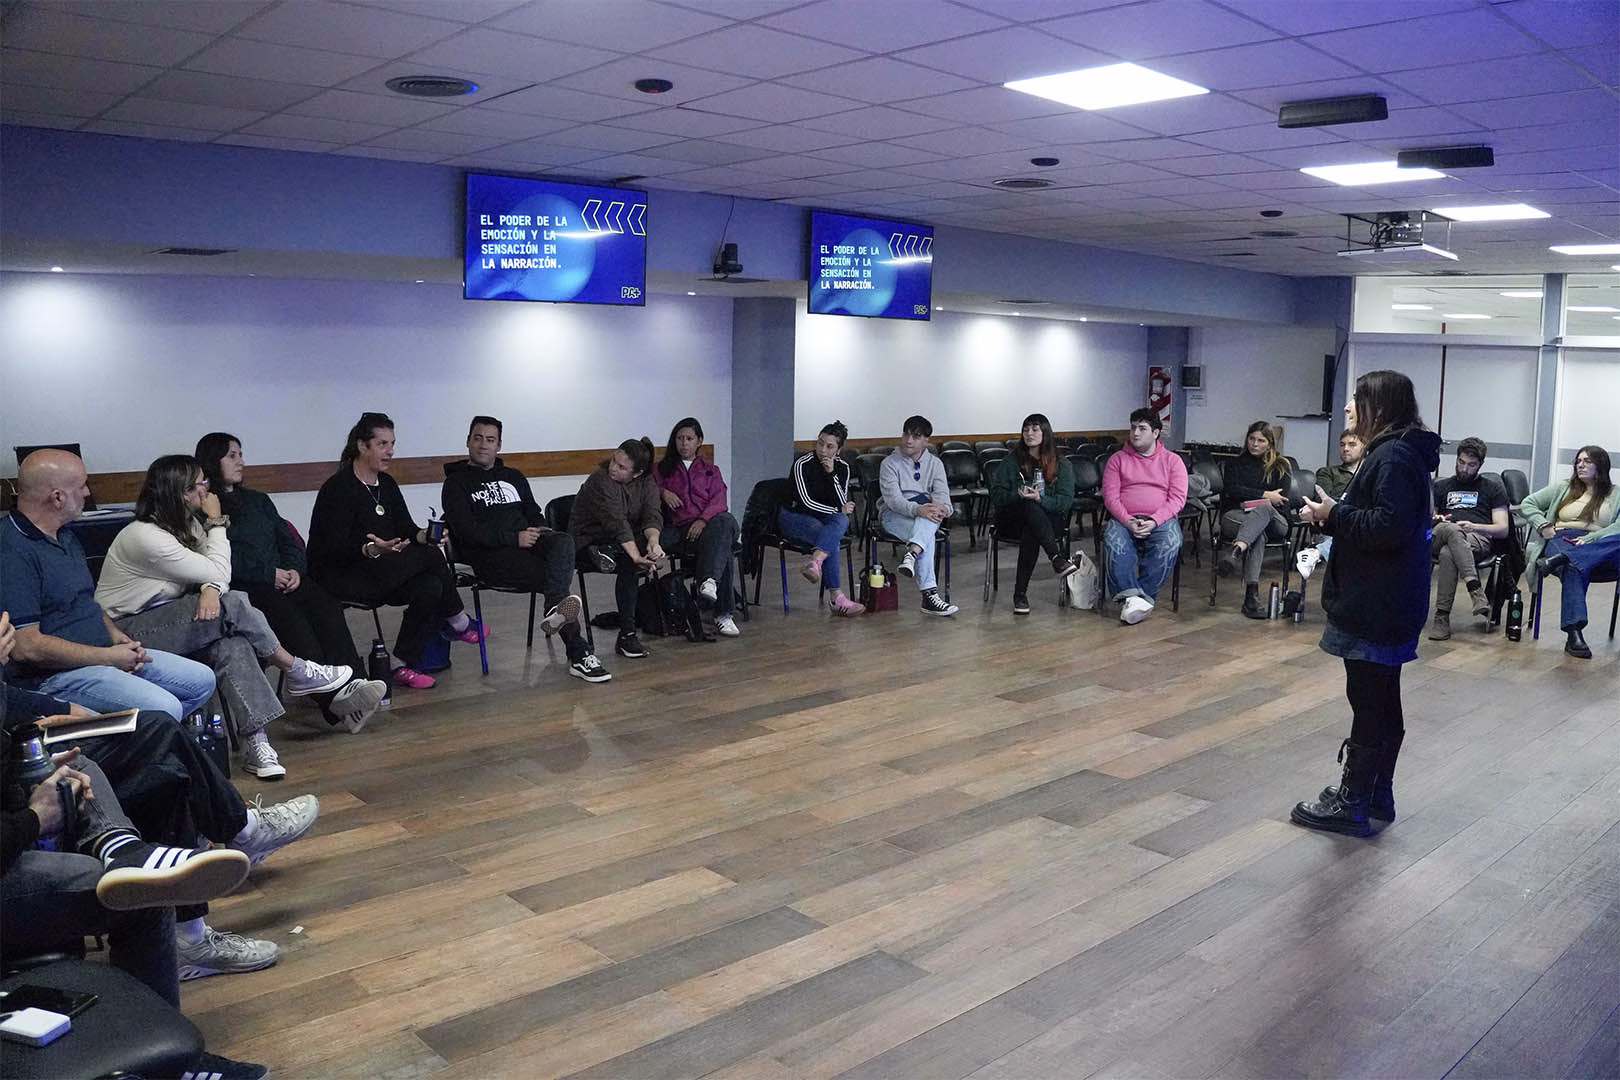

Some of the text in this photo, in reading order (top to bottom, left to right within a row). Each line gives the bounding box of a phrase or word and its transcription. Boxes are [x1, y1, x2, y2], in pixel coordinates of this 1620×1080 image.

[480, 214, 568, 227] EL PODER DE LA
[481, 228, 556, 240] EMOCIÓN Y LA
[481, 242, 556, 254] SENSACIÓN EN
[820, 245, 880, 255] EL PODER DE LA
[482, 256, 562, 269] LA NARRACIÓN.
[820, 256, 871, 267] EMOCIÓN Y LA
[820, 267, 871, 278] SENSACIÓN EN
[821, 279, 875, 290] LA NARRACIÓN.
[484, 496, 506, 507] FACE
